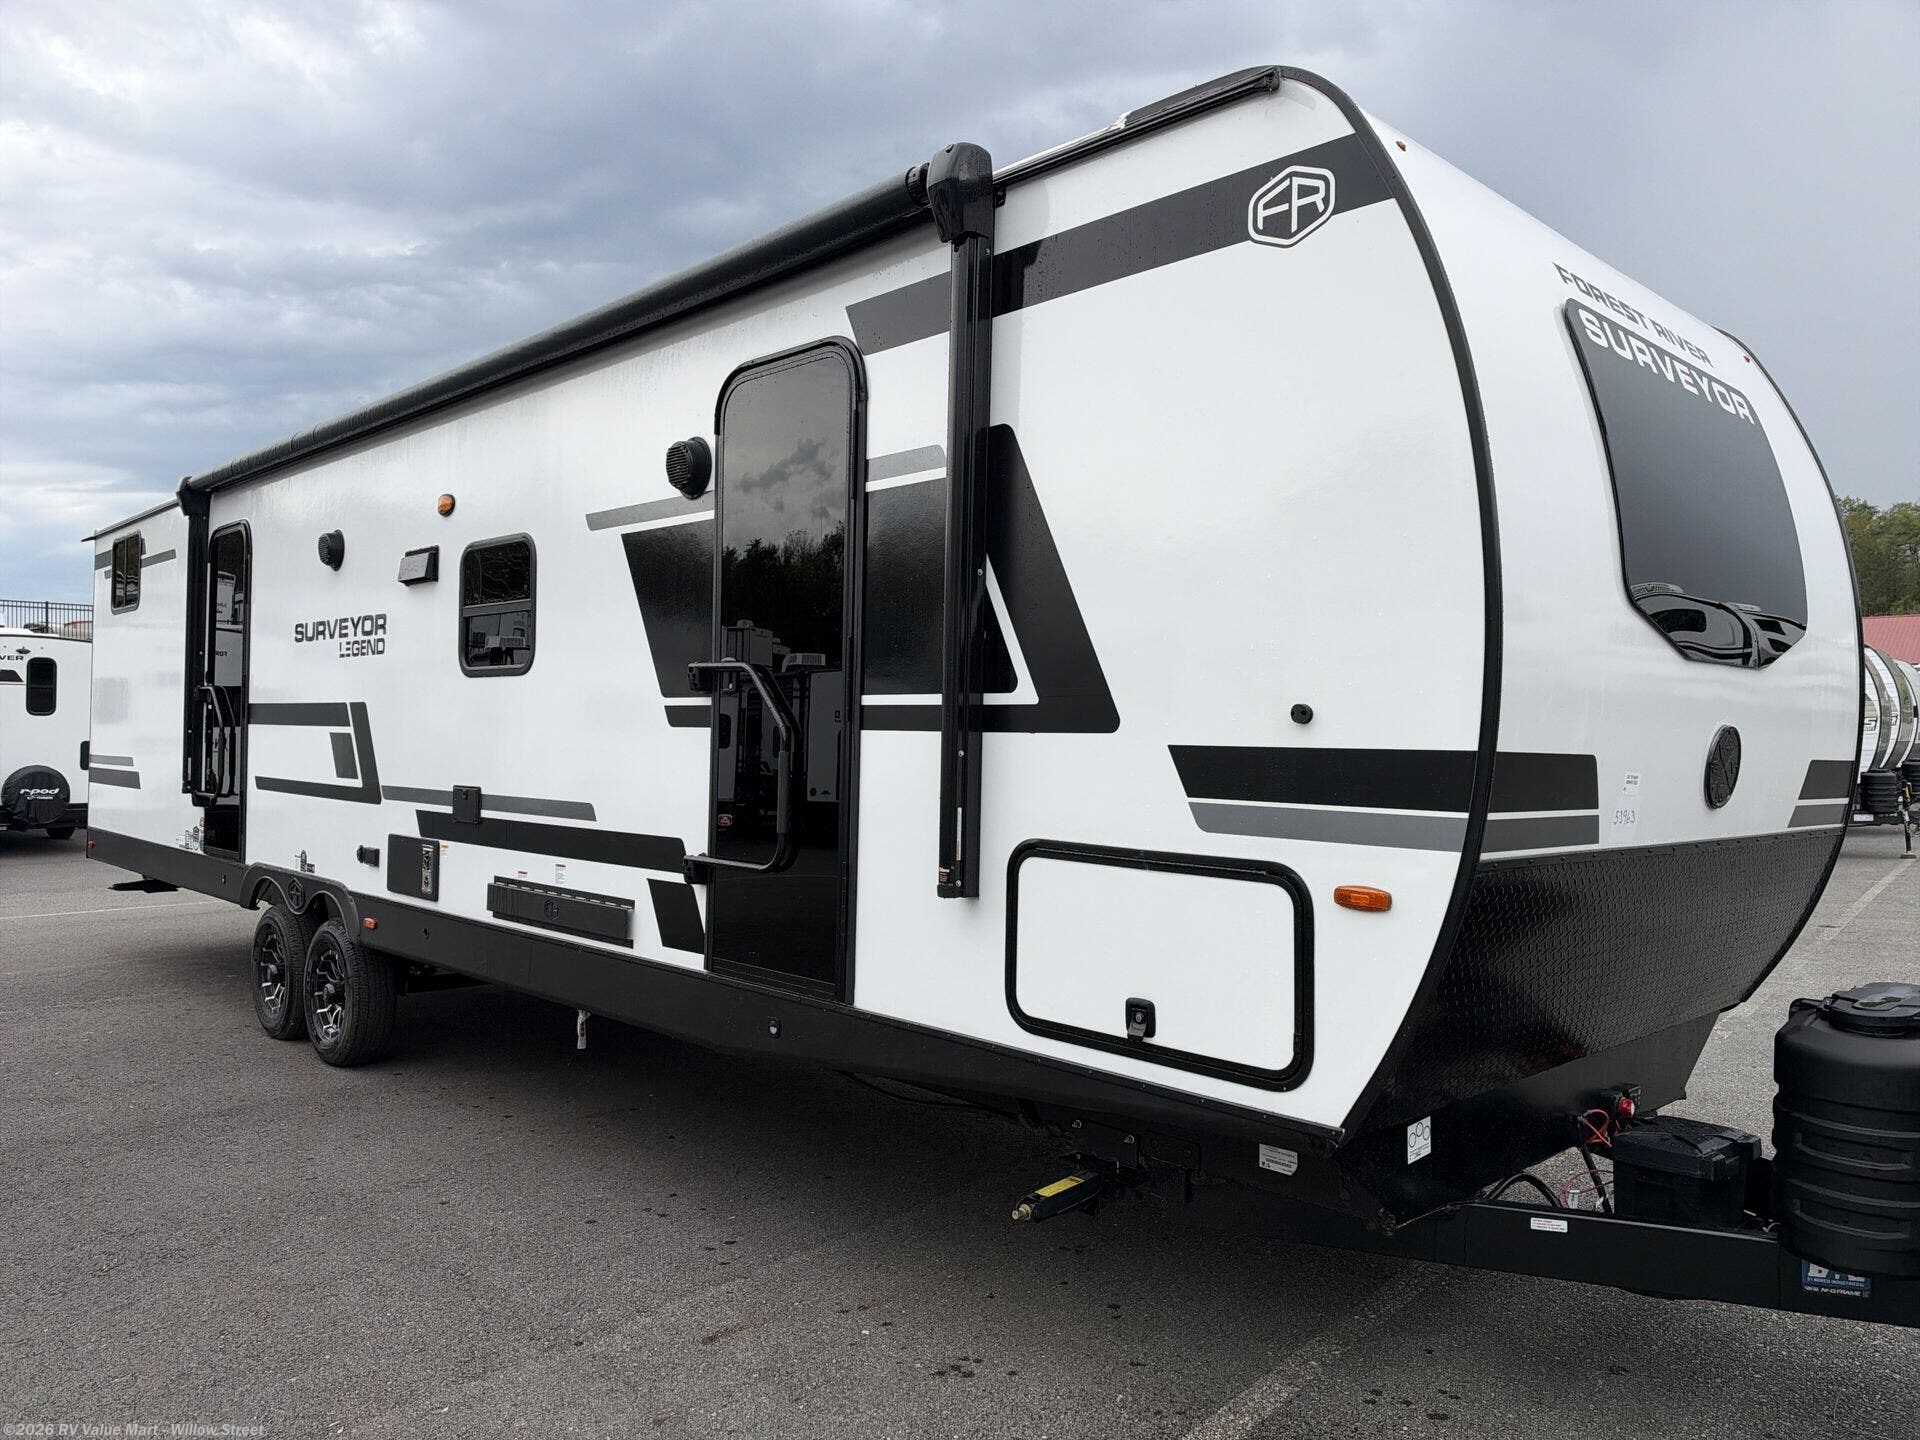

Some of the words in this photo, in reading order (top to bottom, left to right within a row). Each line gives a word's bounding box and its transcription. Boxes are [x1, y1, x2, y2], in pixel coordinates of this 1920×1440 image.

[1256, 175, 1326, 234] FR
[1551, 261, 1649, 330] FOREST
[1647, 317, 1716, 368] RIVER
[1578, 308, 1755, 425] SURVEYOR
[294, 613, 387, 643] SURVEYOR
[339, 637, 386, 658] LEGEND
